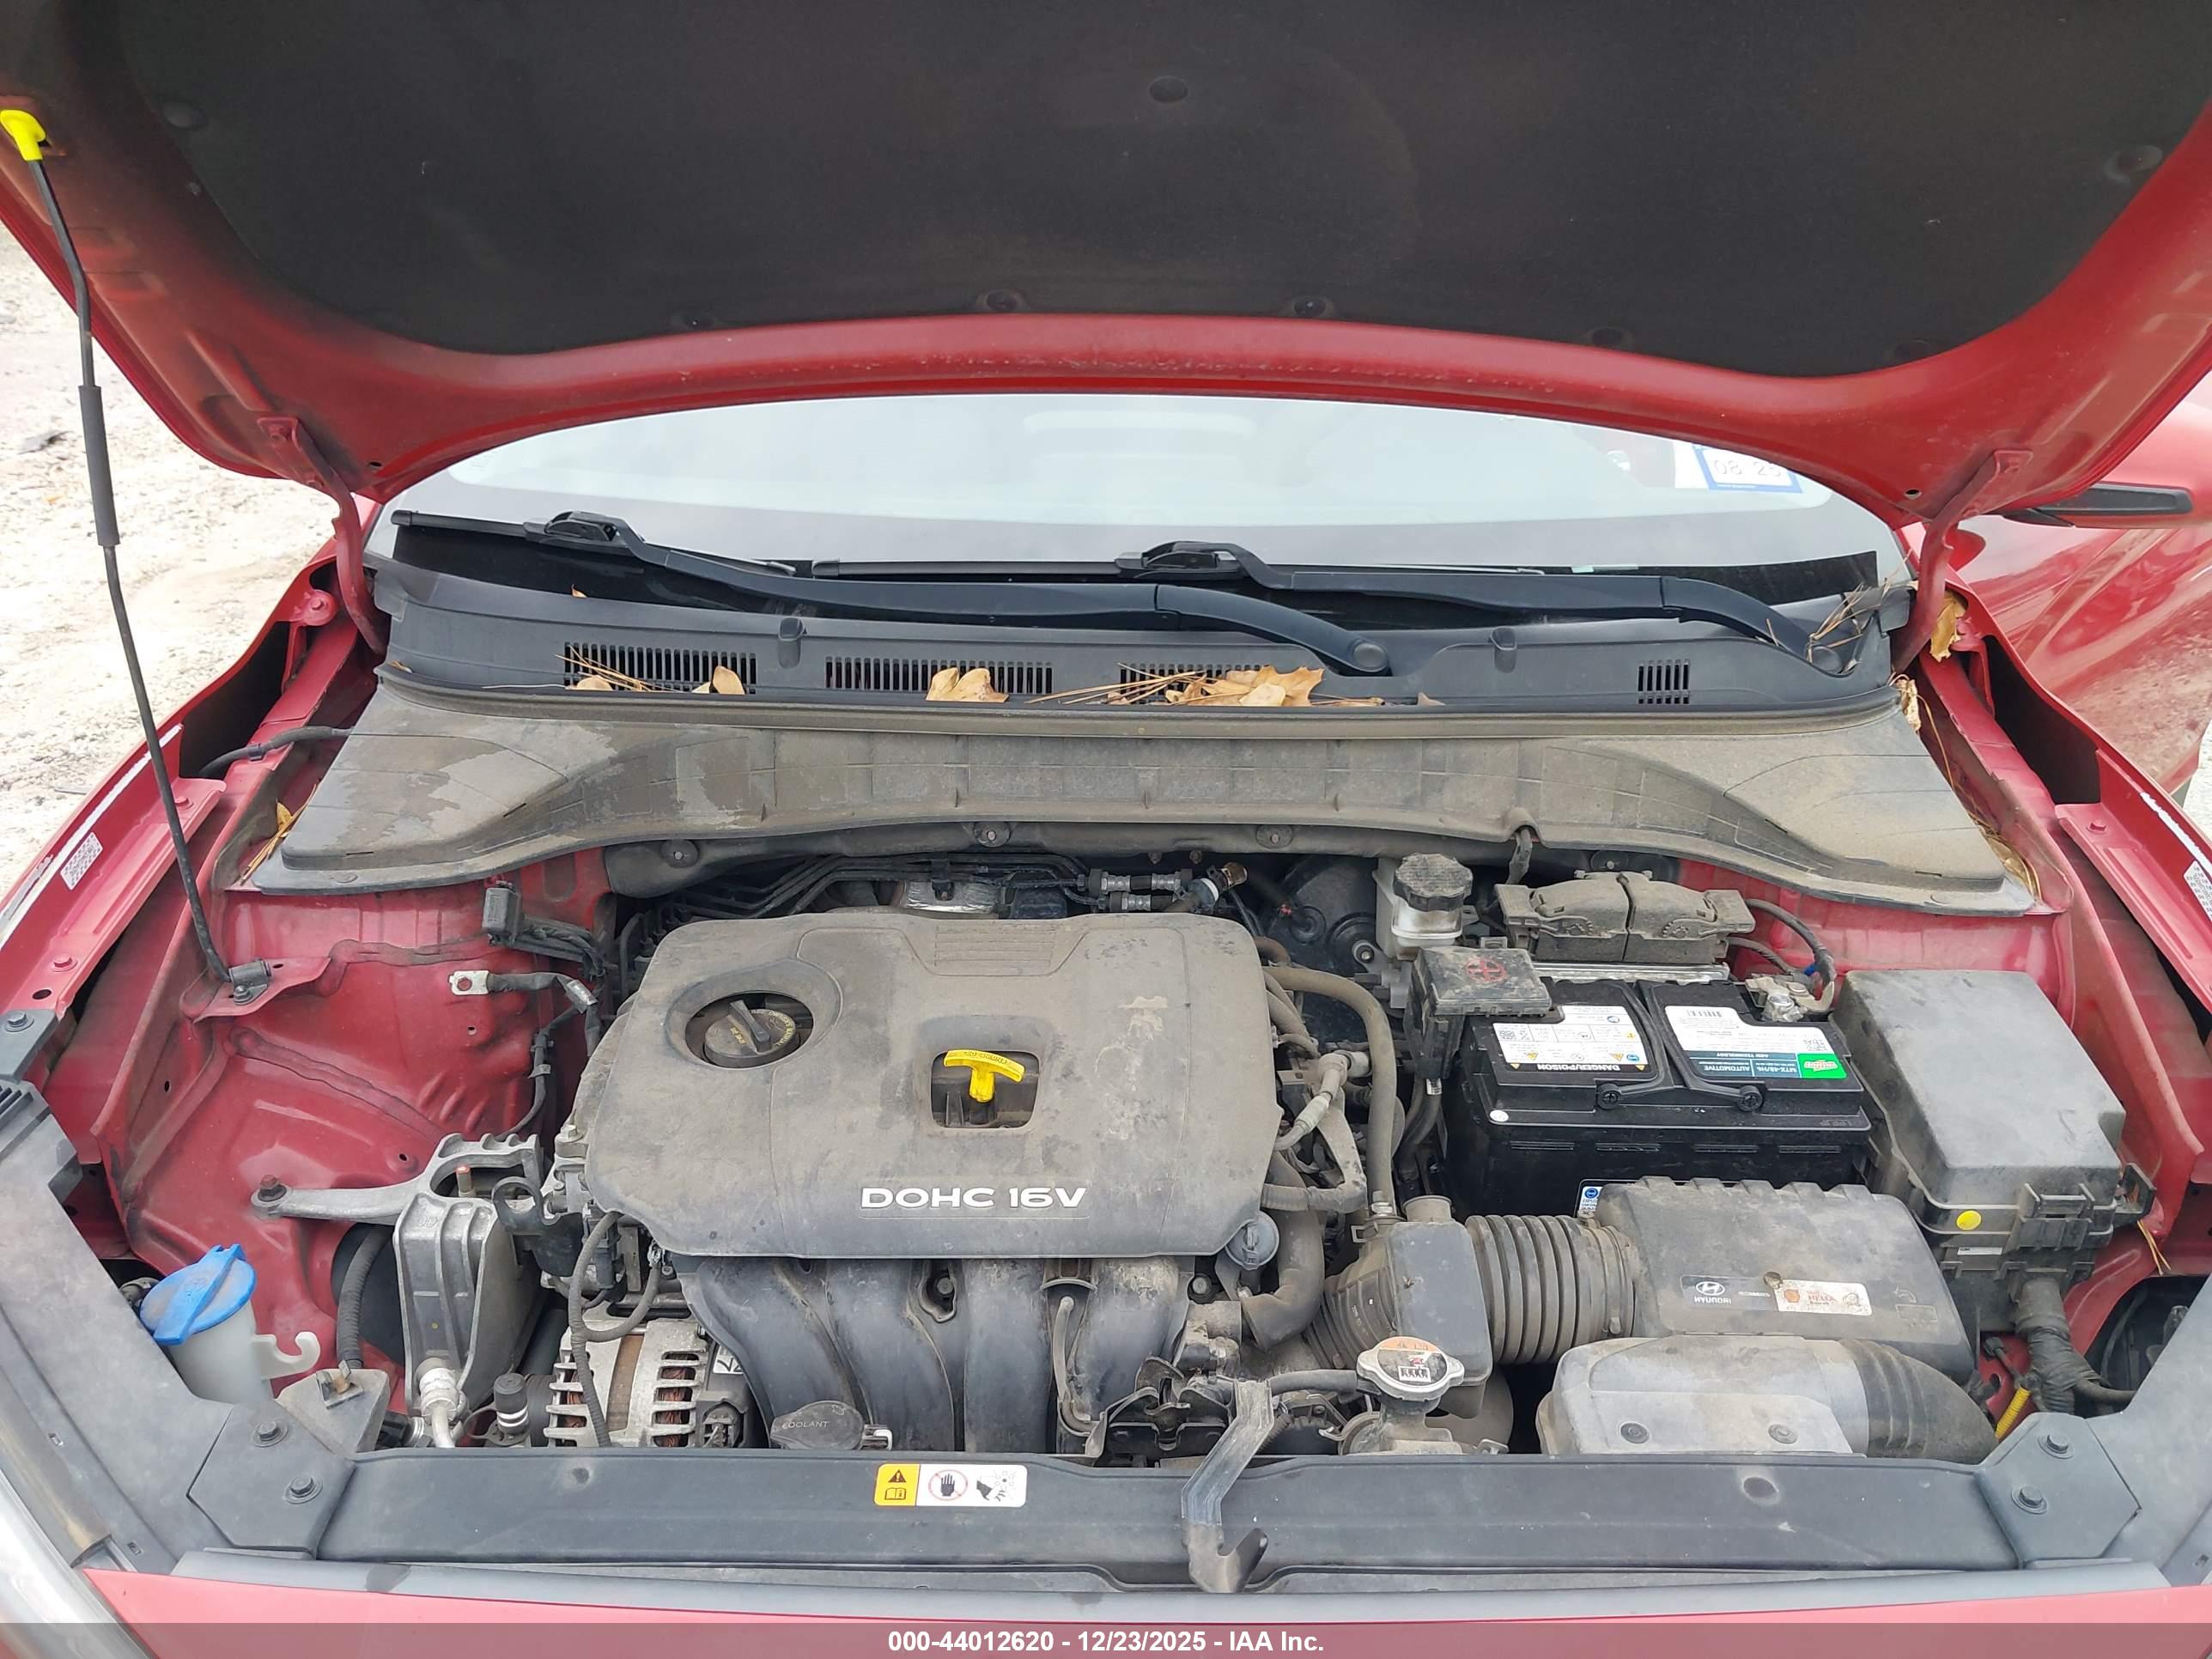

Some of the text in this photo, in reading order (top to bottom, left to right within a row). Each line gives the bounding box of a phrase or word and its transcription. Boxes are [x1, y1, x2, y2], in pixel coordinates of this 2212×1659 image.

[1537, 1063, 1621, 1072] DANGER/POISON
[861, 1187, 1086, 1208] DOHC 16V
[781, 1420, 830, 1430] COOLANT
